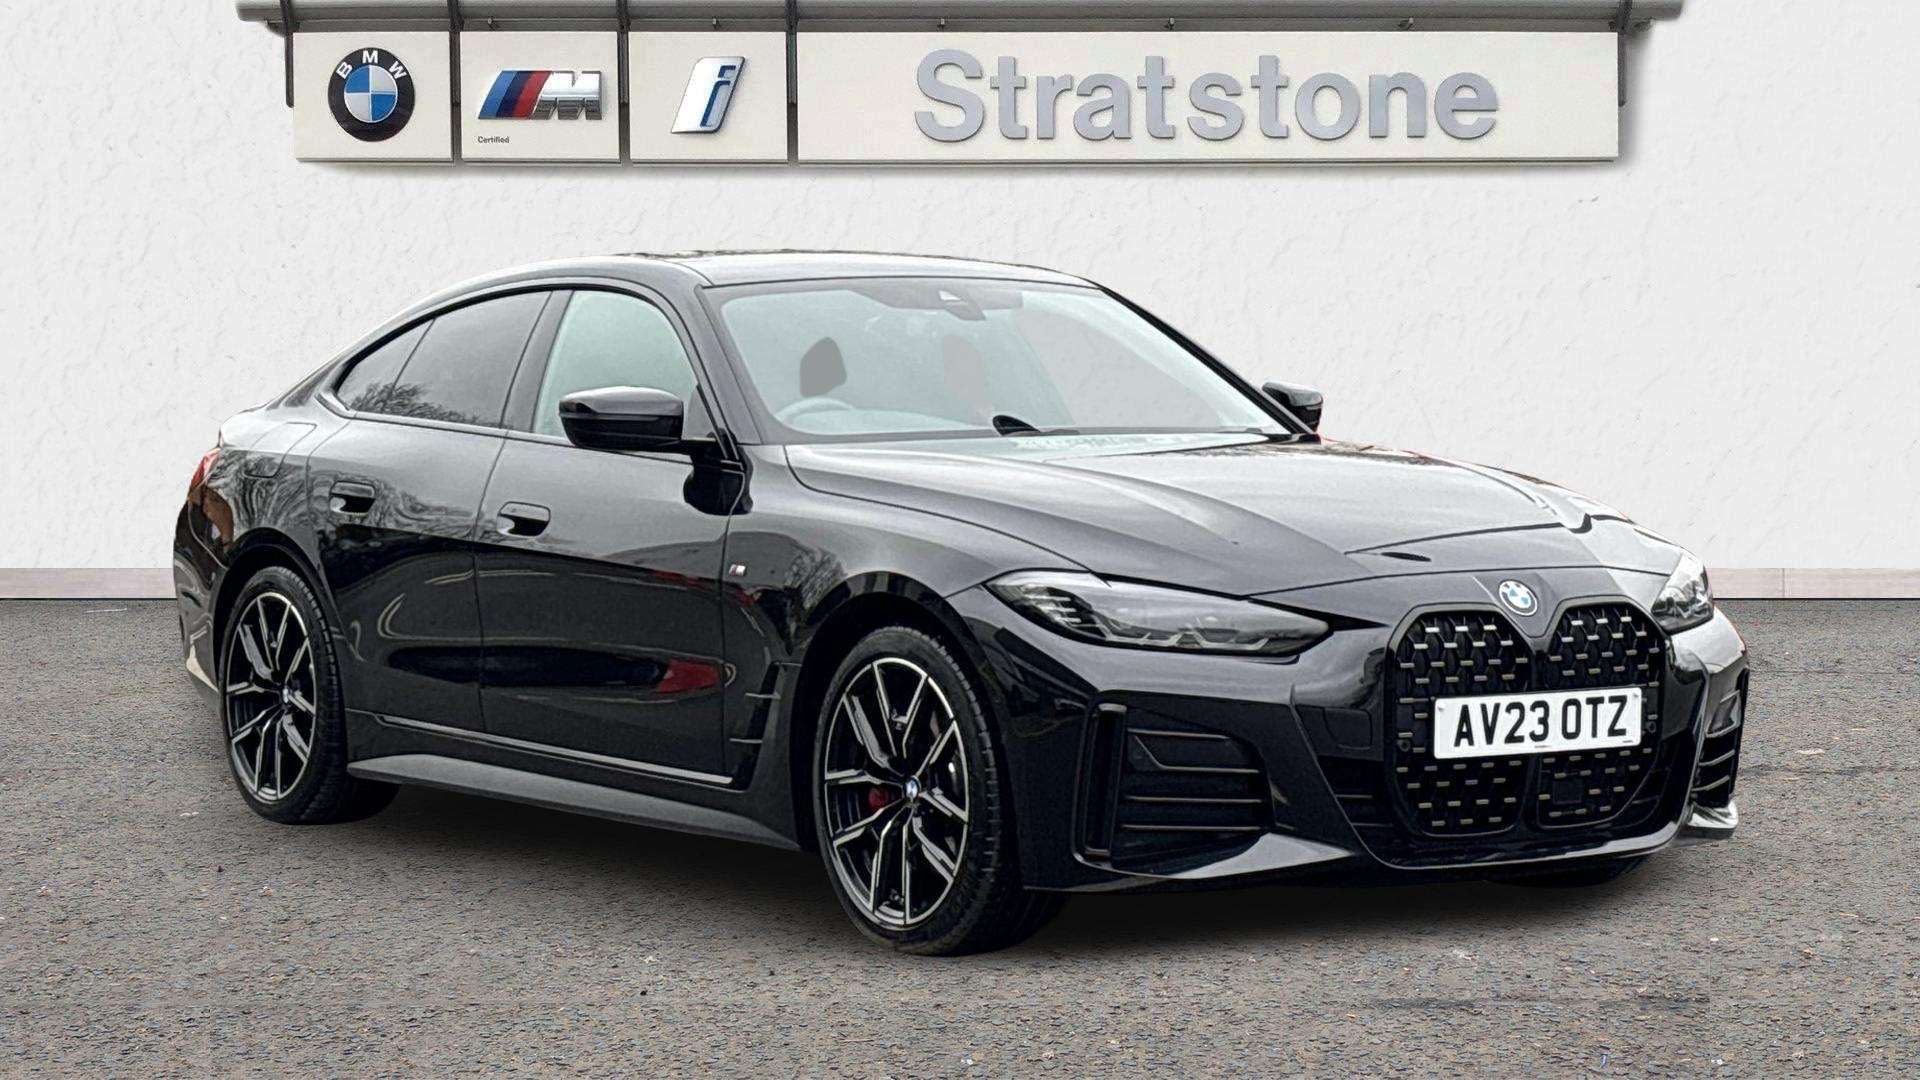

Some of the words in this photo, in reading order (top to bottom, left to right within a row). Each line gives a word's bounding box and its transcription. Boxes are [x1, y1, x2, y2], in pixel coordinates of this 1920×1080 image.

[336, 50, 407, 79] BMW
[914, 48, 1500, 143] Stratstone
[477, 136, 510, 144] Certified
[1453, 700, 1550, 748] AV23
[1561, 694, 1628, 741] OTZ
